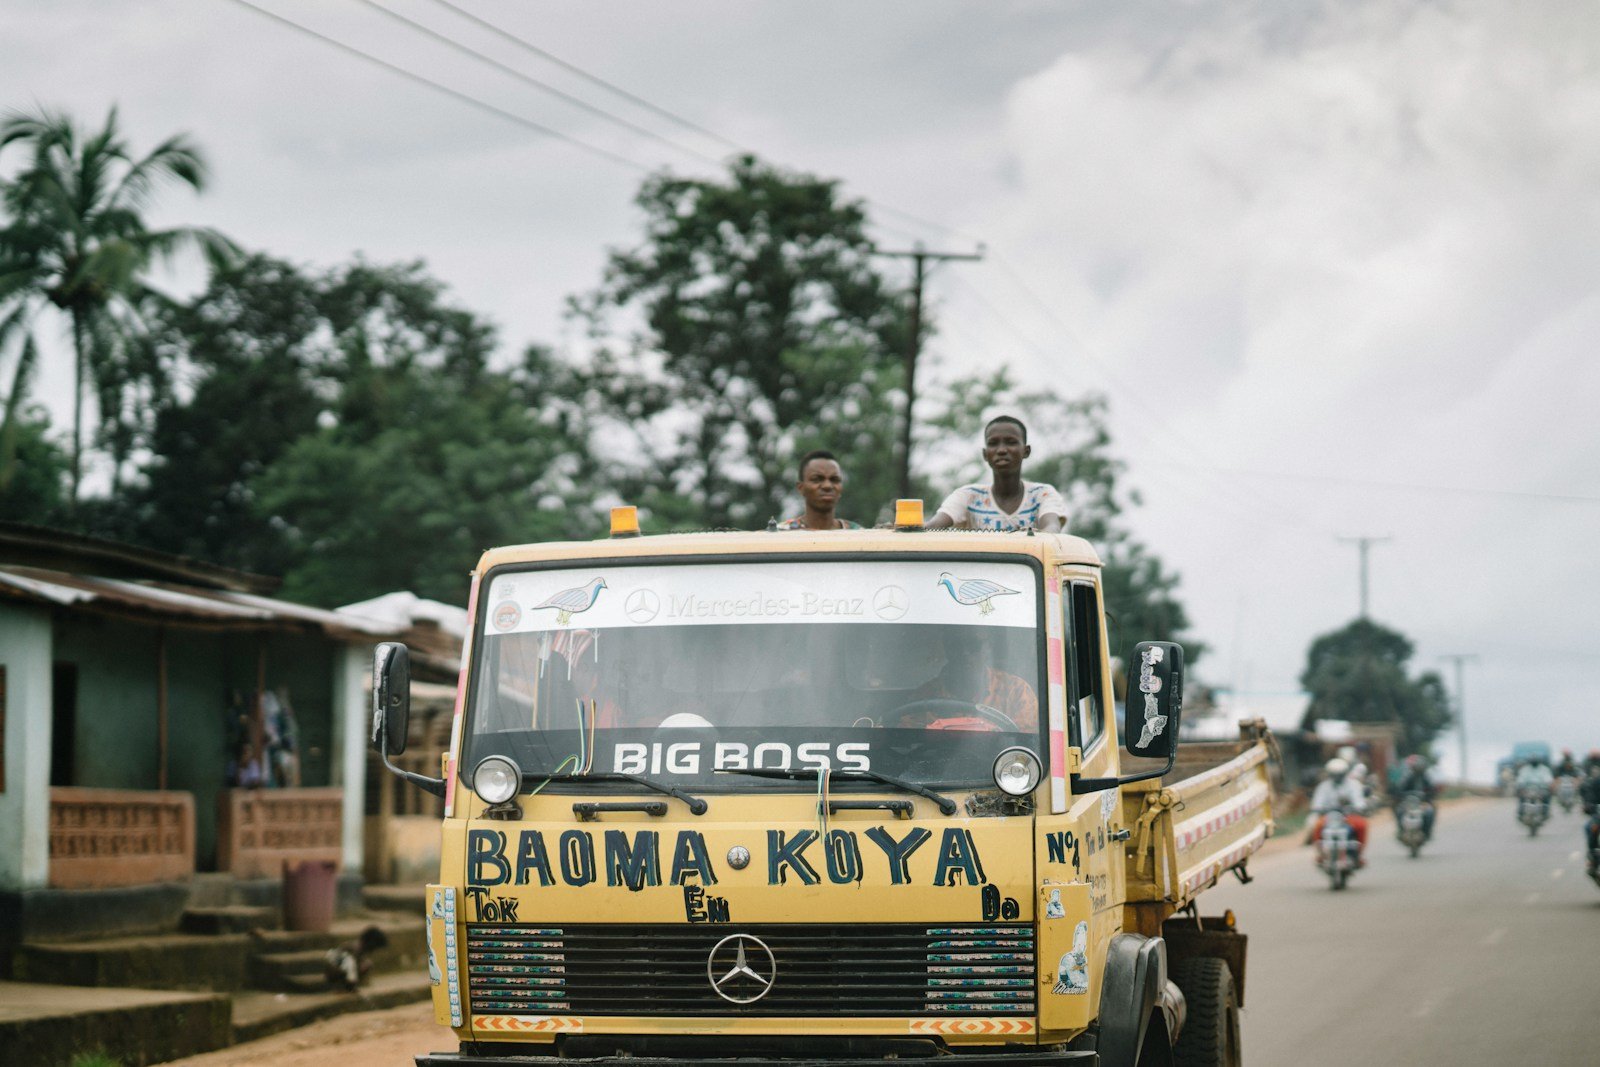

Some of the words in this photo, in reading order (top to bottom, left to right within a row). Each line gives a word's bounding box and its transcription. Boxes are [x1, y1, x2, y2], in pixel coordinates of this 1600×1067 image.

[667, 591, 864, 618] Mercedes-Benz
[613, 742, 701, 775] BIG
[714, 742, 871, 774] BOSS
[467, 829, 719, 891] BAOMA
[766, 825, 987, 888] KOYA
